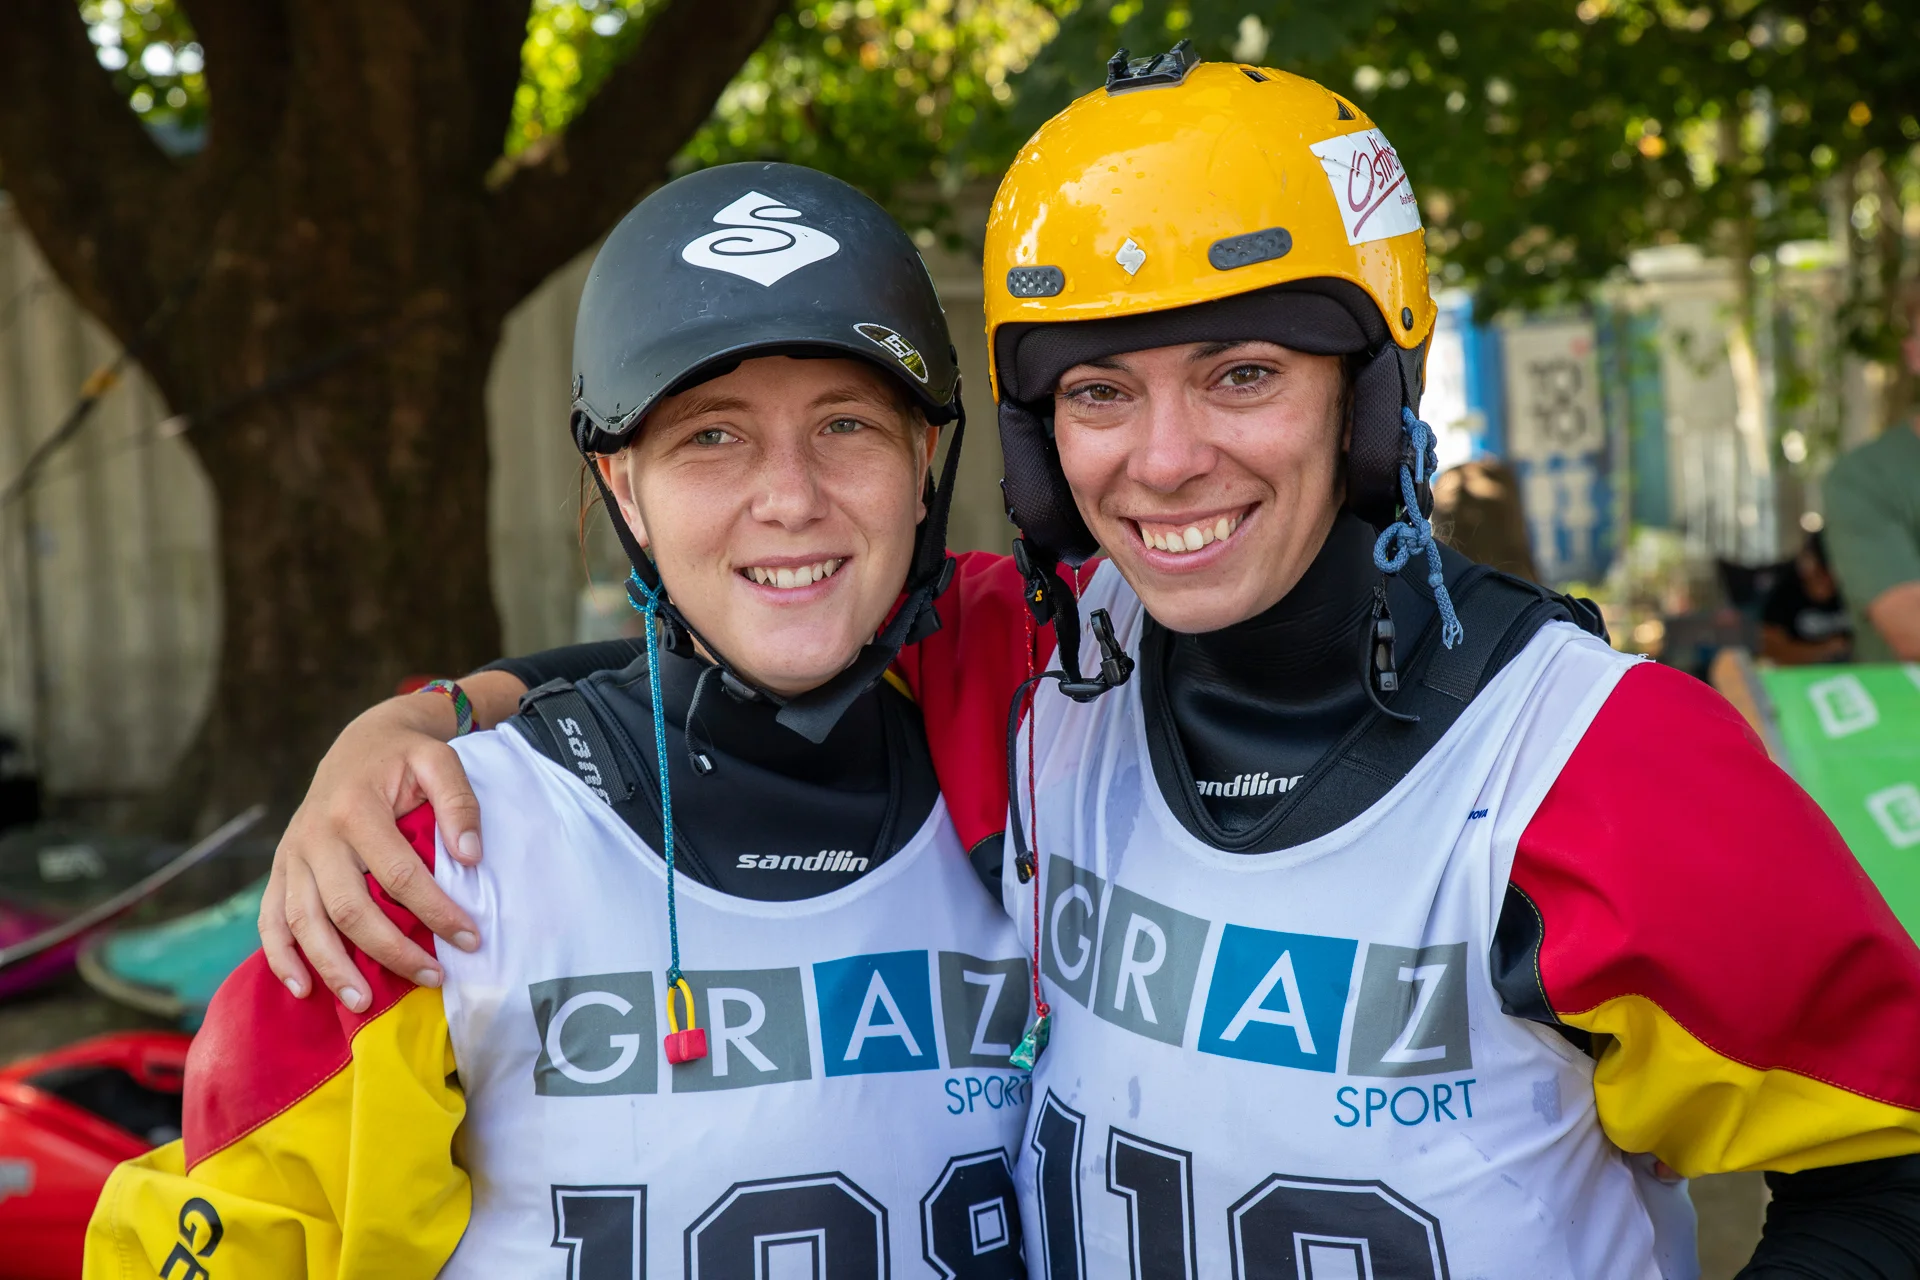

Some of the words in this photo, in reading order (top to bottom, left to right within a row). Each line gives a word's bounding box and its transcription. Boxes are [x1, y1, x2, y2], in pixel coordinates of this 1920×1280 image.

[1196, 772, 1304, 797] andilin
[736, 850, 869, 872] sandilin
[1050, 883, 1448, 1063] GRAZ
[546, 969, 1012, 1085] GRAZ
[945, 1074, 1032, 1115] SPORT
[1334, 1078, 1476, 1128] SPORT
